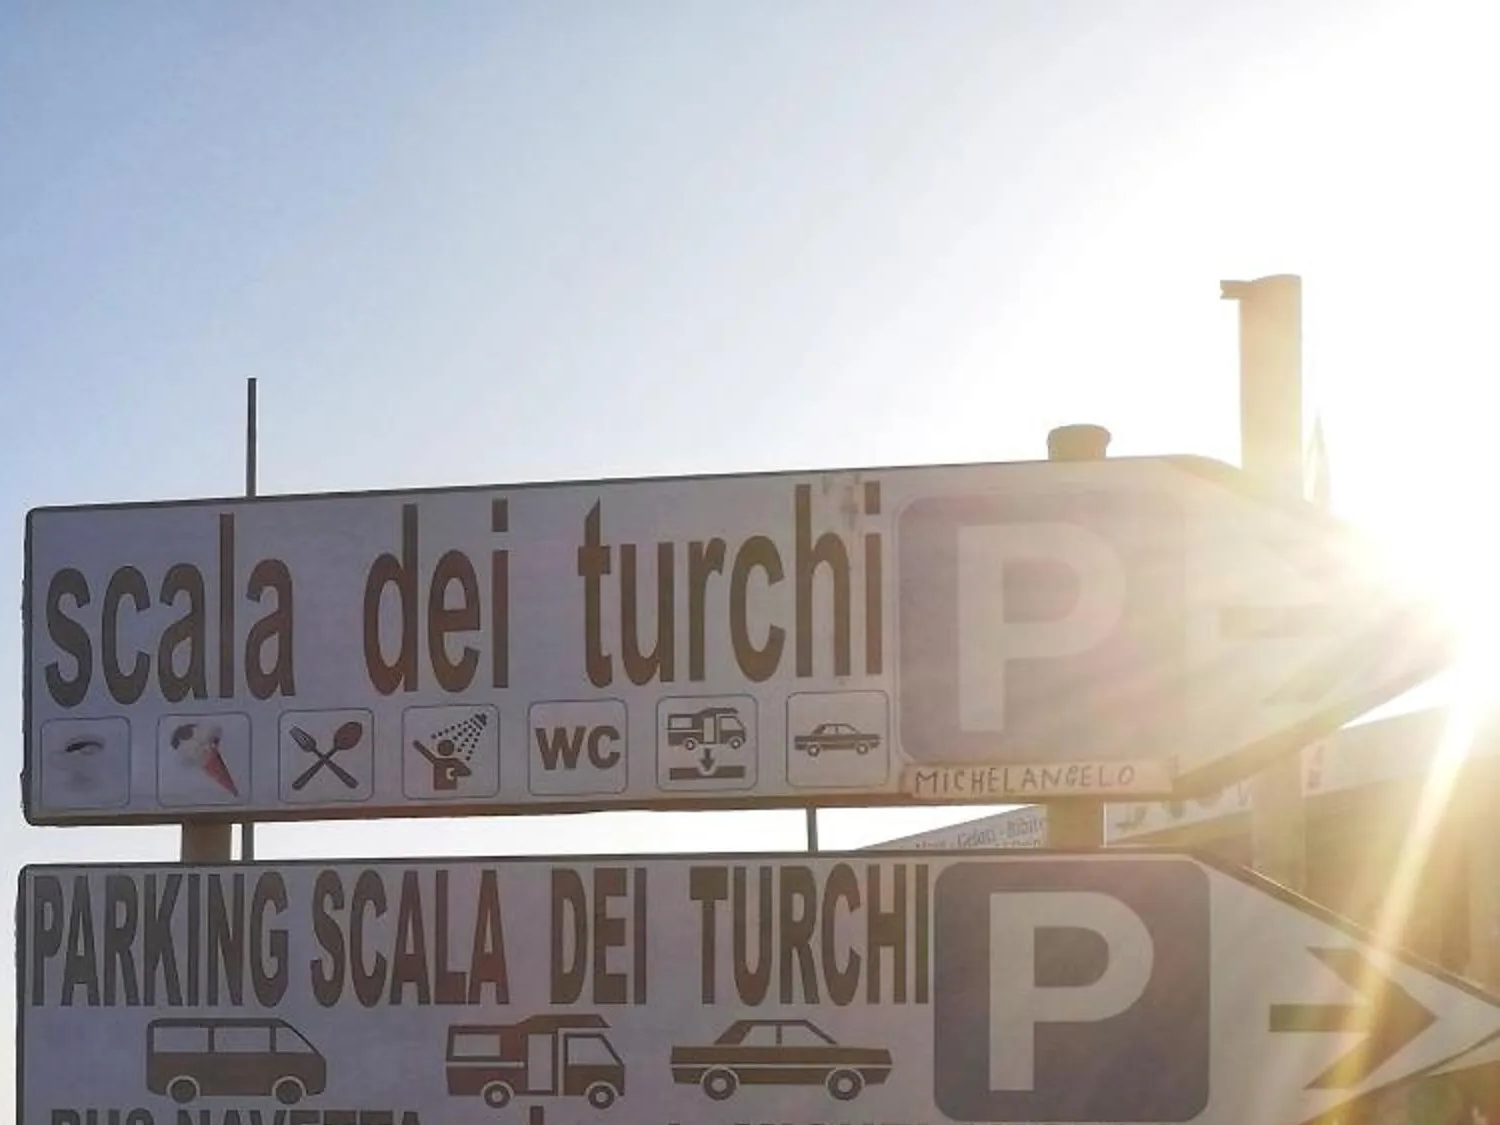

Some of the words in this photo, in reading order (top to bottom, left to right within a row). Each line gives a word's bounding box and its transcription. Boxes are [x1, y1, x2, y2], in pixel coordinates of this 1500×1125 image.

[44, 513, 296, 708] scala
[363, 499, 509, 695] dei
[577, 480, 882, 689] turchi
[958, 520, 1128, 731] P
[536, 724, 621, 770] WC
[31, 870, 290, 1008] PARKING
[311, 868, 509, 1008] SCALA
[549, 866, 648, 1006] DEI
[690, 862, 930, 1007] TURCHI
[989, 891, 1155, 1092] P
